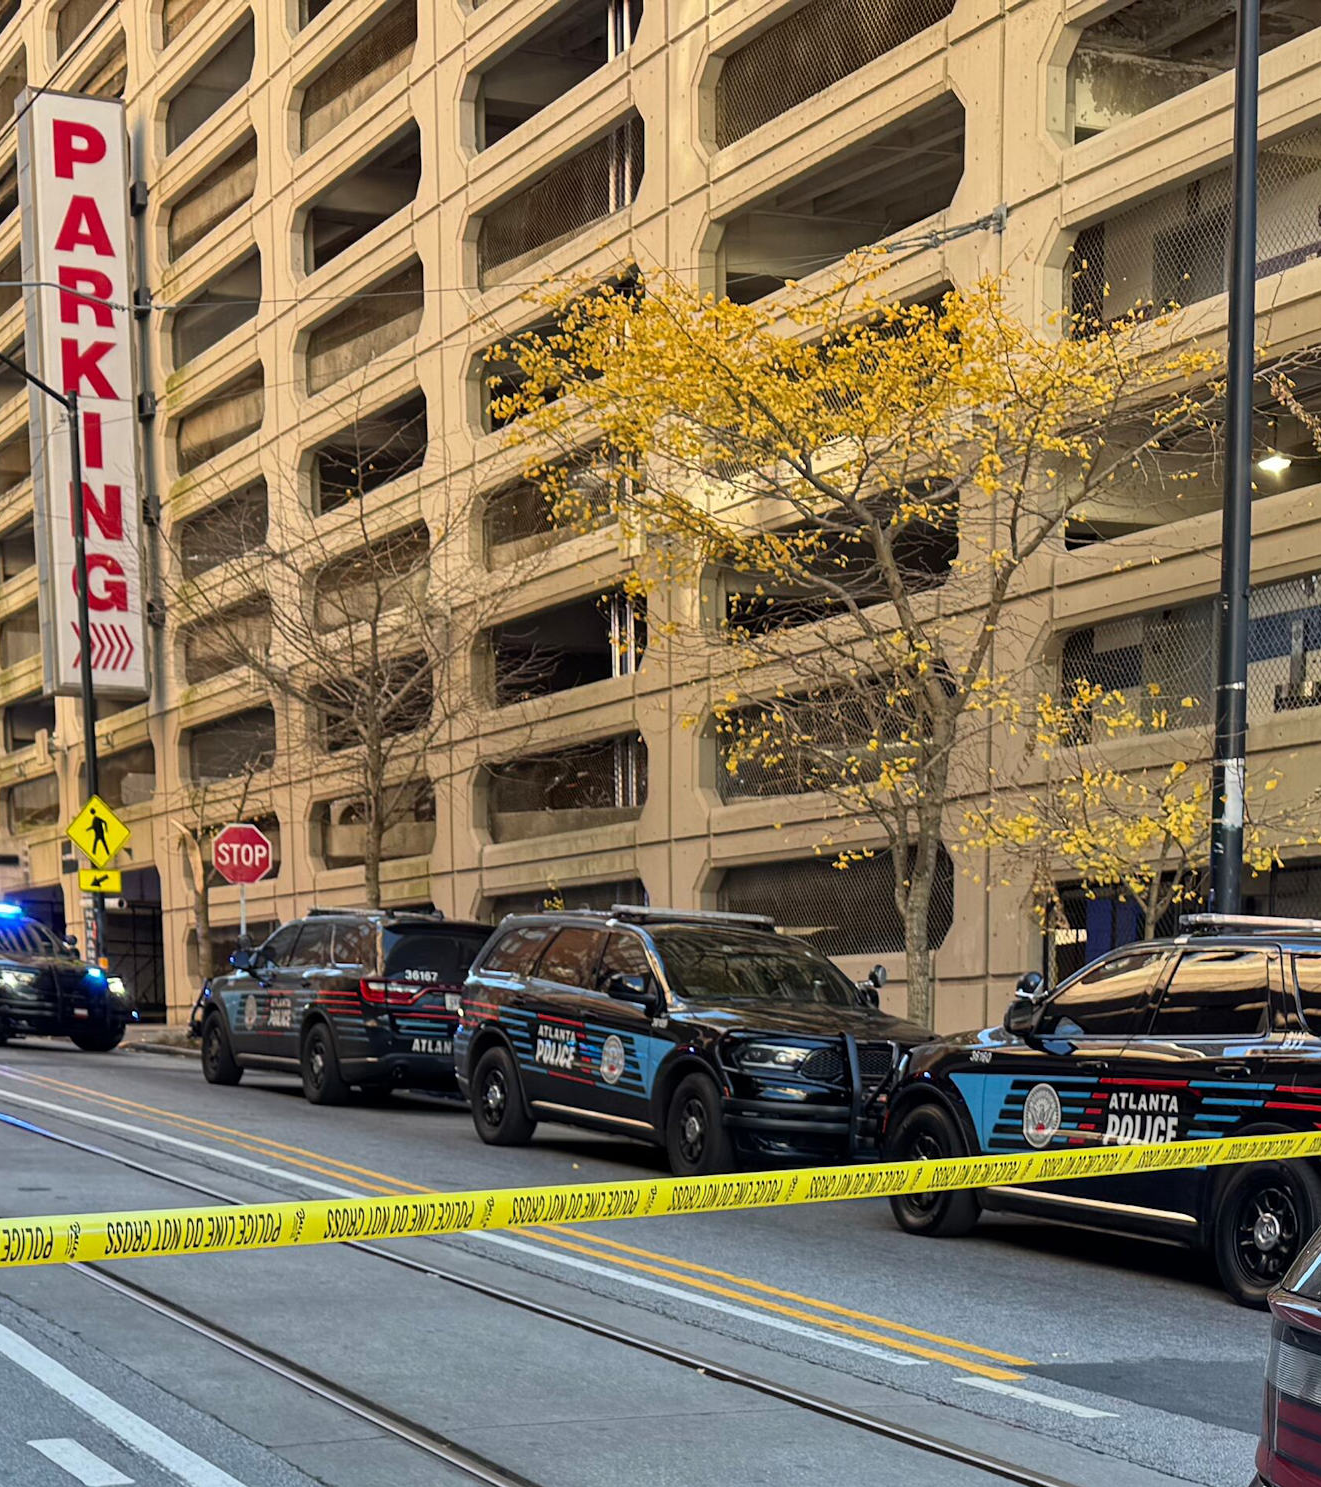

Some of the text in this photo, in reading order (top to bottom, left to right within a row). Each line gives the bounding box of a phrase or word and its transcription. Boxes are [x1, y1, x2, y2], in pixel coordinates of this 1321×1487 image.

[52, 117, 128, 613] PARKING
[218, 843, 267, 867] STOP
[404, 969, 438, 981] 36167
[411, 1038, 454, 1055] ATLAN
[537, 1024, 577, 1042] ATLANTA
[535, 1038, 577, 1069] POLICE
[1108, 1092, 1179, 1113] ATLANTA
[1102, 1113, 1179, 1146] POLICE
[321, 1207, 365, 1239] CROSS
[361, 1206, 390, 1235] NOT
[387, 1205, 408, 1233] DO
[405, 1203, 435, 1232] LINE
[431, 1200, 475, 1230] POLICE
[102, 1212, 282, 1254] POLICE LINE DO NOT CROSS
